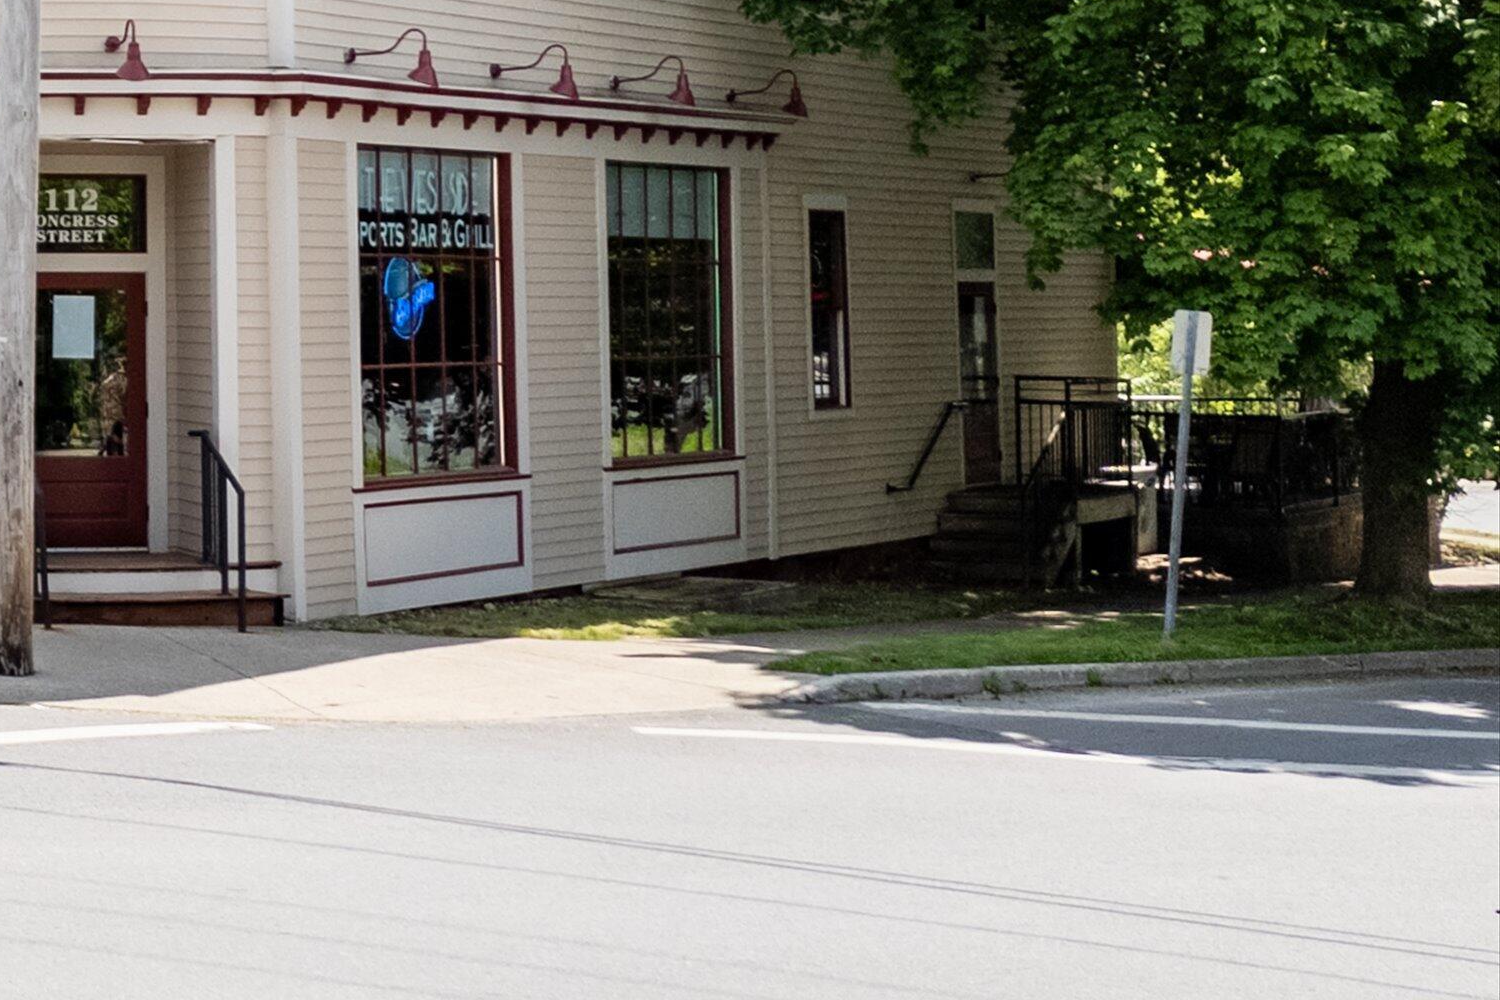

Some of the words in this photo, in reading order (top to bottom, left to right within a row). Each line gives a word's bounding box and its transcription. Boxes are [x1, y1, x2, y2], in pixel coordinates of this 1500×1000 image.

[45, 188, 98, 212] 112
[37, 214, 119, 228] ONGRESS
[37, 230, 106, 243] STREET
[360, 221, 404, 248] PORTS
